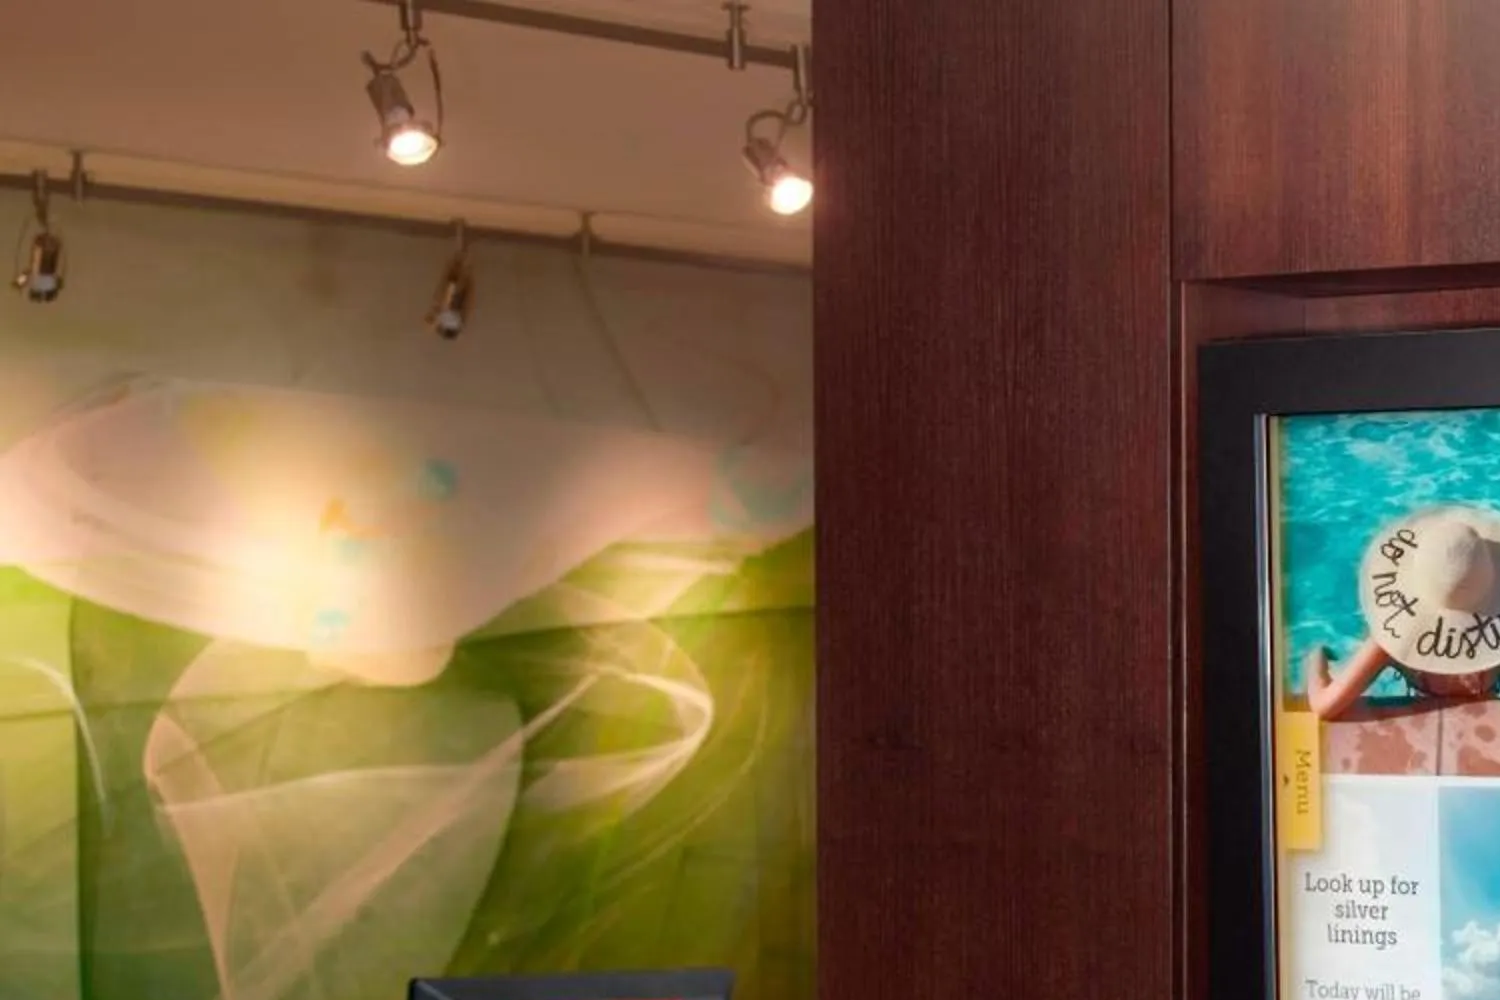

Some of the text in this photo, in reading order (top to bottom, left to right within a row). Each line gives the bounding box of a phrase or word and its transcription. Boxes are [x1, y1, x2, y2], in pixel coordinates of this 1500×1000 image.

[1372, 570, 1419, 617] not
[1295, 748, 1312, 816] Menu
[1304, 871, 1420, 899] Look up for
[1334, 900, 1389, 920] silver
[1327, 923, 1398, 950] linings
